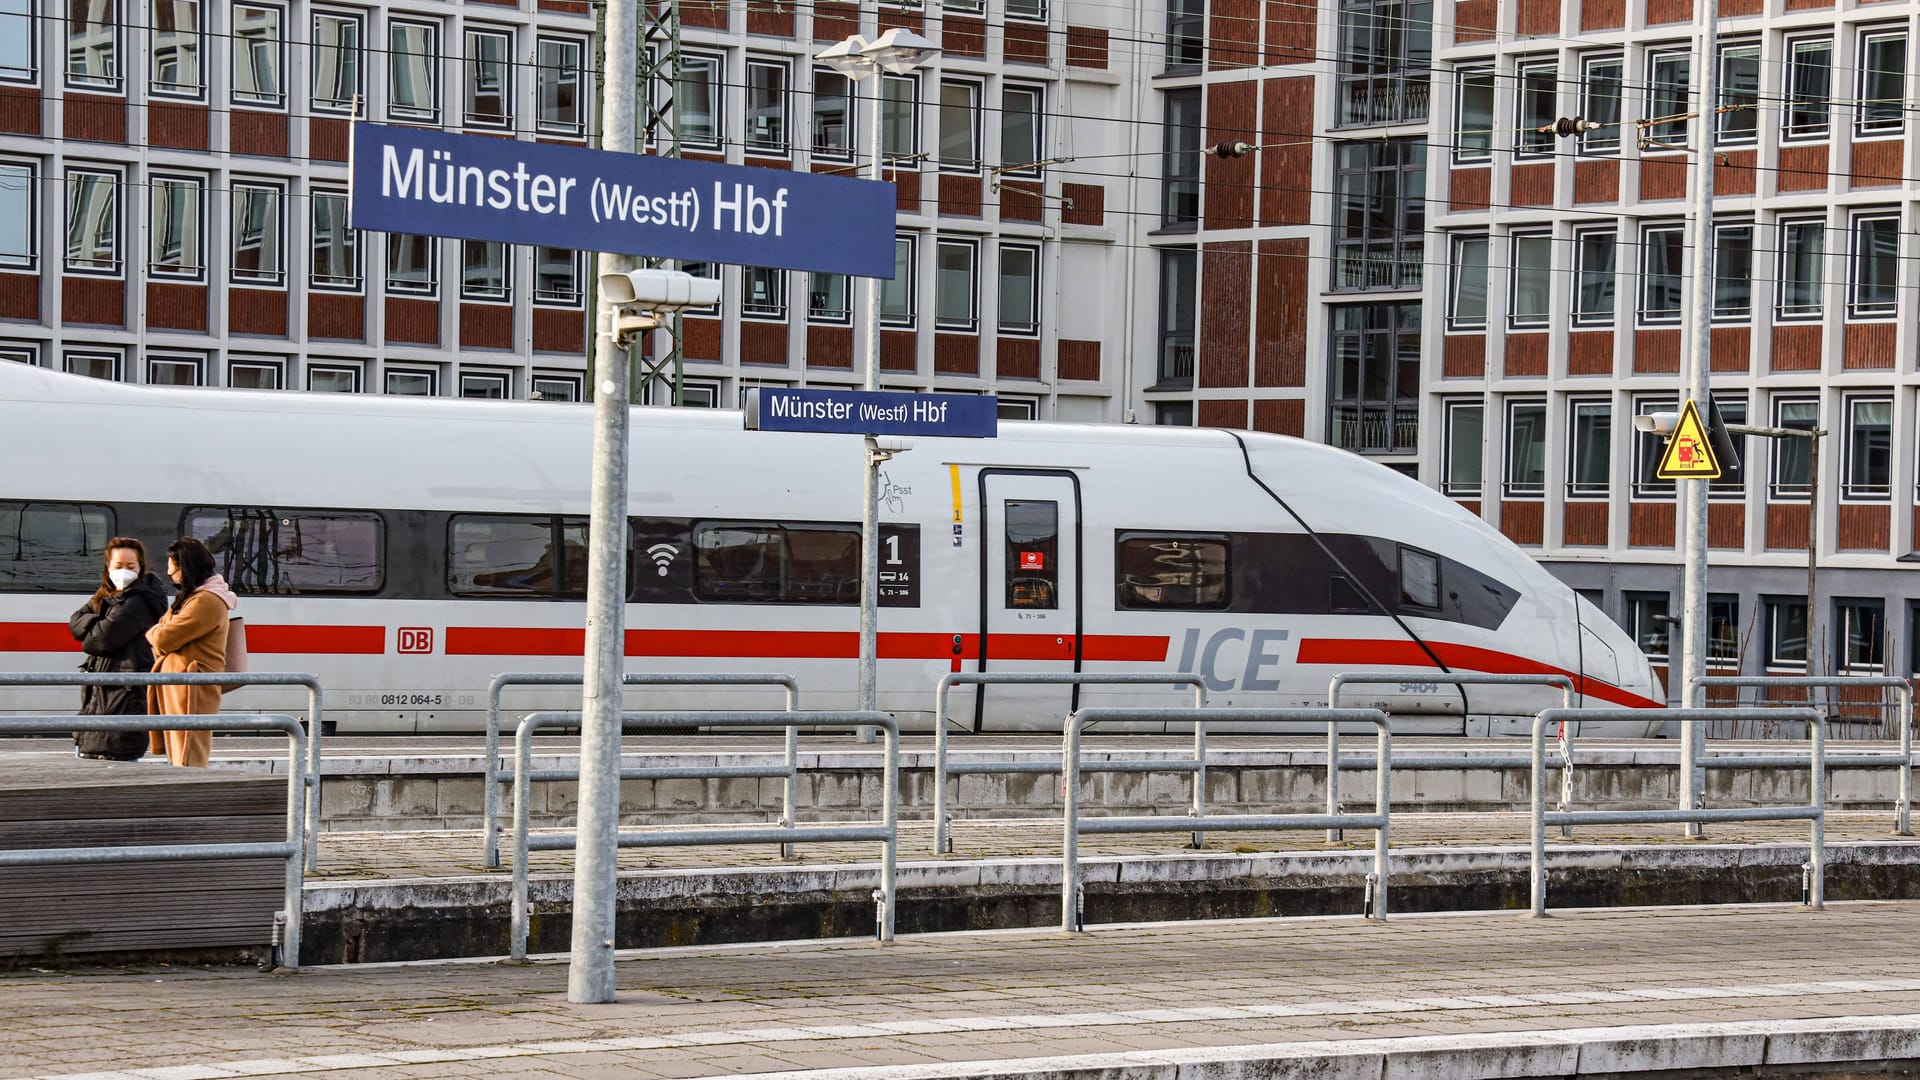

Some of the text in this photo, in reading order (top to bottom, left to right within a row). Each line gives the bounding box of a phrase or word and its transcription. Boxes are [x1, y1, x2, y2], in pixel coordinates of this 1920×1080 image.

[382, 144, 788, 237] Münster (Westf) Hbf
[771, 395, 948, 423] Münster (Westf) Hbf
[893, 485, 912, 495] Psst
[954, 510, 961, 521] 1
[886, 535, 903, 565] 1
[898, 572, 909, 582] 14
[401, 631, 429, 650] DB
[1173, 627, 1289, 692] ICE
[381, 694, 408, 705] 0812
[410, 694, 442, 705] 064-5
